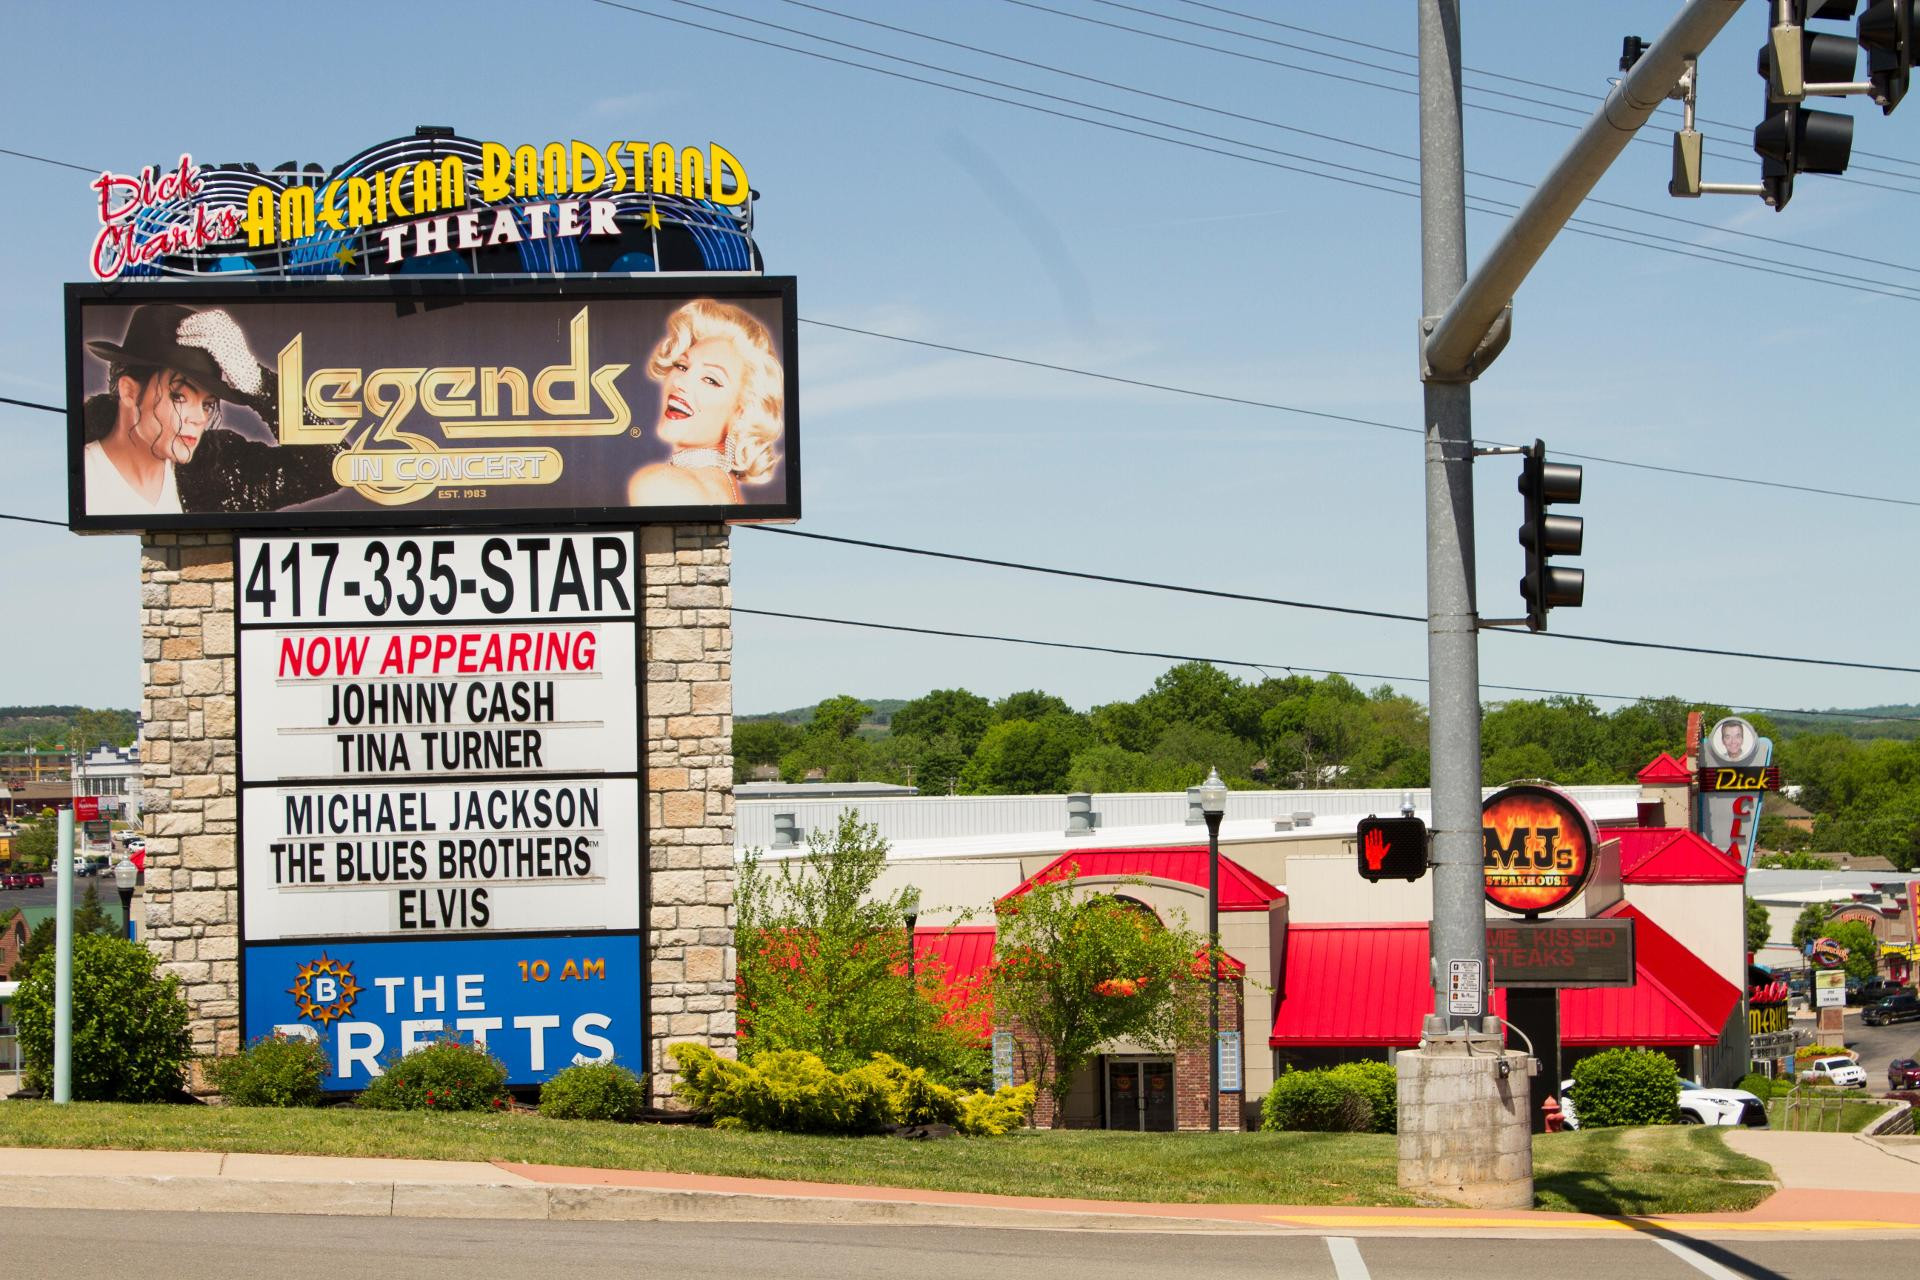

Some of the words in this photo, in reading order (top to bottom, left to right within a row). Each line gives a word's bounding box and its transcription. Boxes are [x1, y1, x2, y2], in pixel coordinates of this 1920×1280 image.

[91, 153, 204, 224] Dick
[241, 155, 466, 248] AMERICAN
[476, 139, 750, 206] BANDSTAND
[380, 200, 622, 264] THEATER
[278, 306, 632, 450] Legends
[351, 456, 383, 482] IN
[394, 453, 547, 480] CONCERT
[438, 489, 461, 499] EST.
[464, 489, 487, 499] 1983
[245, 536, 631, 618] 417-335-STAR
[278, 635, 370, 677] NOW
[379, 630, 596, 675] APPEARING
[328, 682, 458, 726] JOHNNY
[466, 681, 554, 723] CASH
[337, 733, 411, 773] TINA
[421, 729, 543, 770] TURNER
[1715, 768, 1769, 790] Dick
[286, 791, 436, 836] MICHAEL
[449, 787, 599, 831] JACKSON
[1726, 795, 1753, 861] CLA
[269, 842, 325, 883] THE
[336, 839, 427, 882] BLUES
[438, 836, 592, 880] BROTHERS
[1486, 875, 1568, 887] STEAKHOUSE
[399, 887, 490, 929] ELVIS
[1533, 928, 1616, 948] KISSED
[316, 978, 337, 1002] B
[518, 959, 550, 983] 10
[560, 957, 606, 981] AM
[374, 974, 486, 1014] THE
